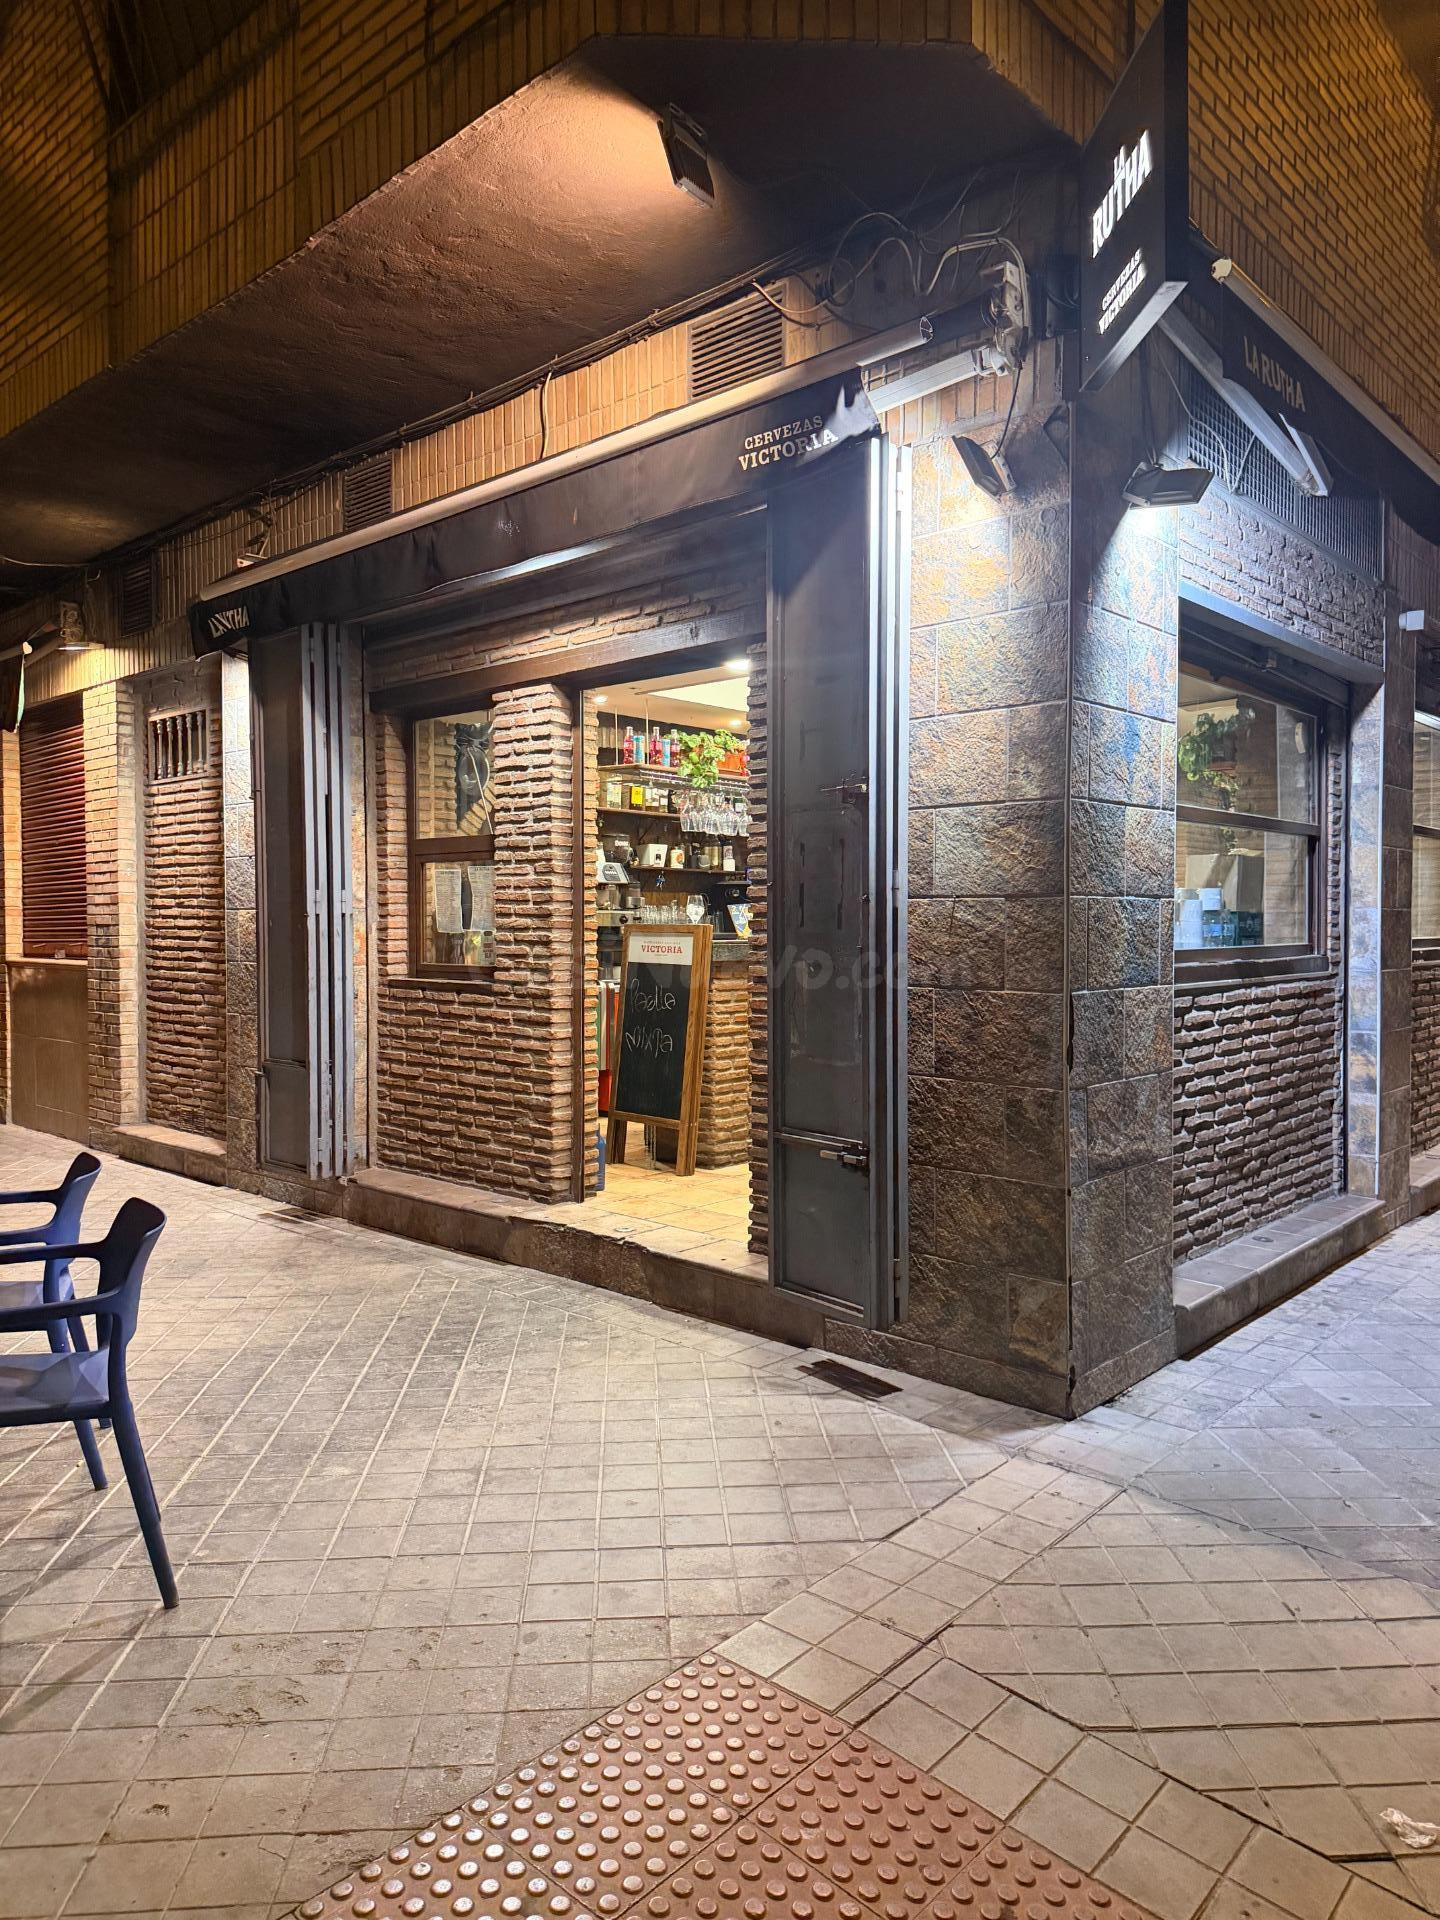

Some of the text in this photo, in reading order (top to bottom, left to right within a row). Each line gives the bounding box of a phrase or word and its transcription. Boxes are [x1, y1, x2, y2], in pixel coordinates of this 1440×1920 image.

[1092, 129, 1152, 259] RUTHA
[1098, 262, 1147, 335] VICTORIA
[1102, 247, 1142, 311] CERVEZAS
[1243, 335, 1306, 413] LA RUTHA
[738, 428, 839, 471] VICTORIA
[744, 415, 824, 450] CERVEZAS
[641, 944, 683, 954] VICTORIA
